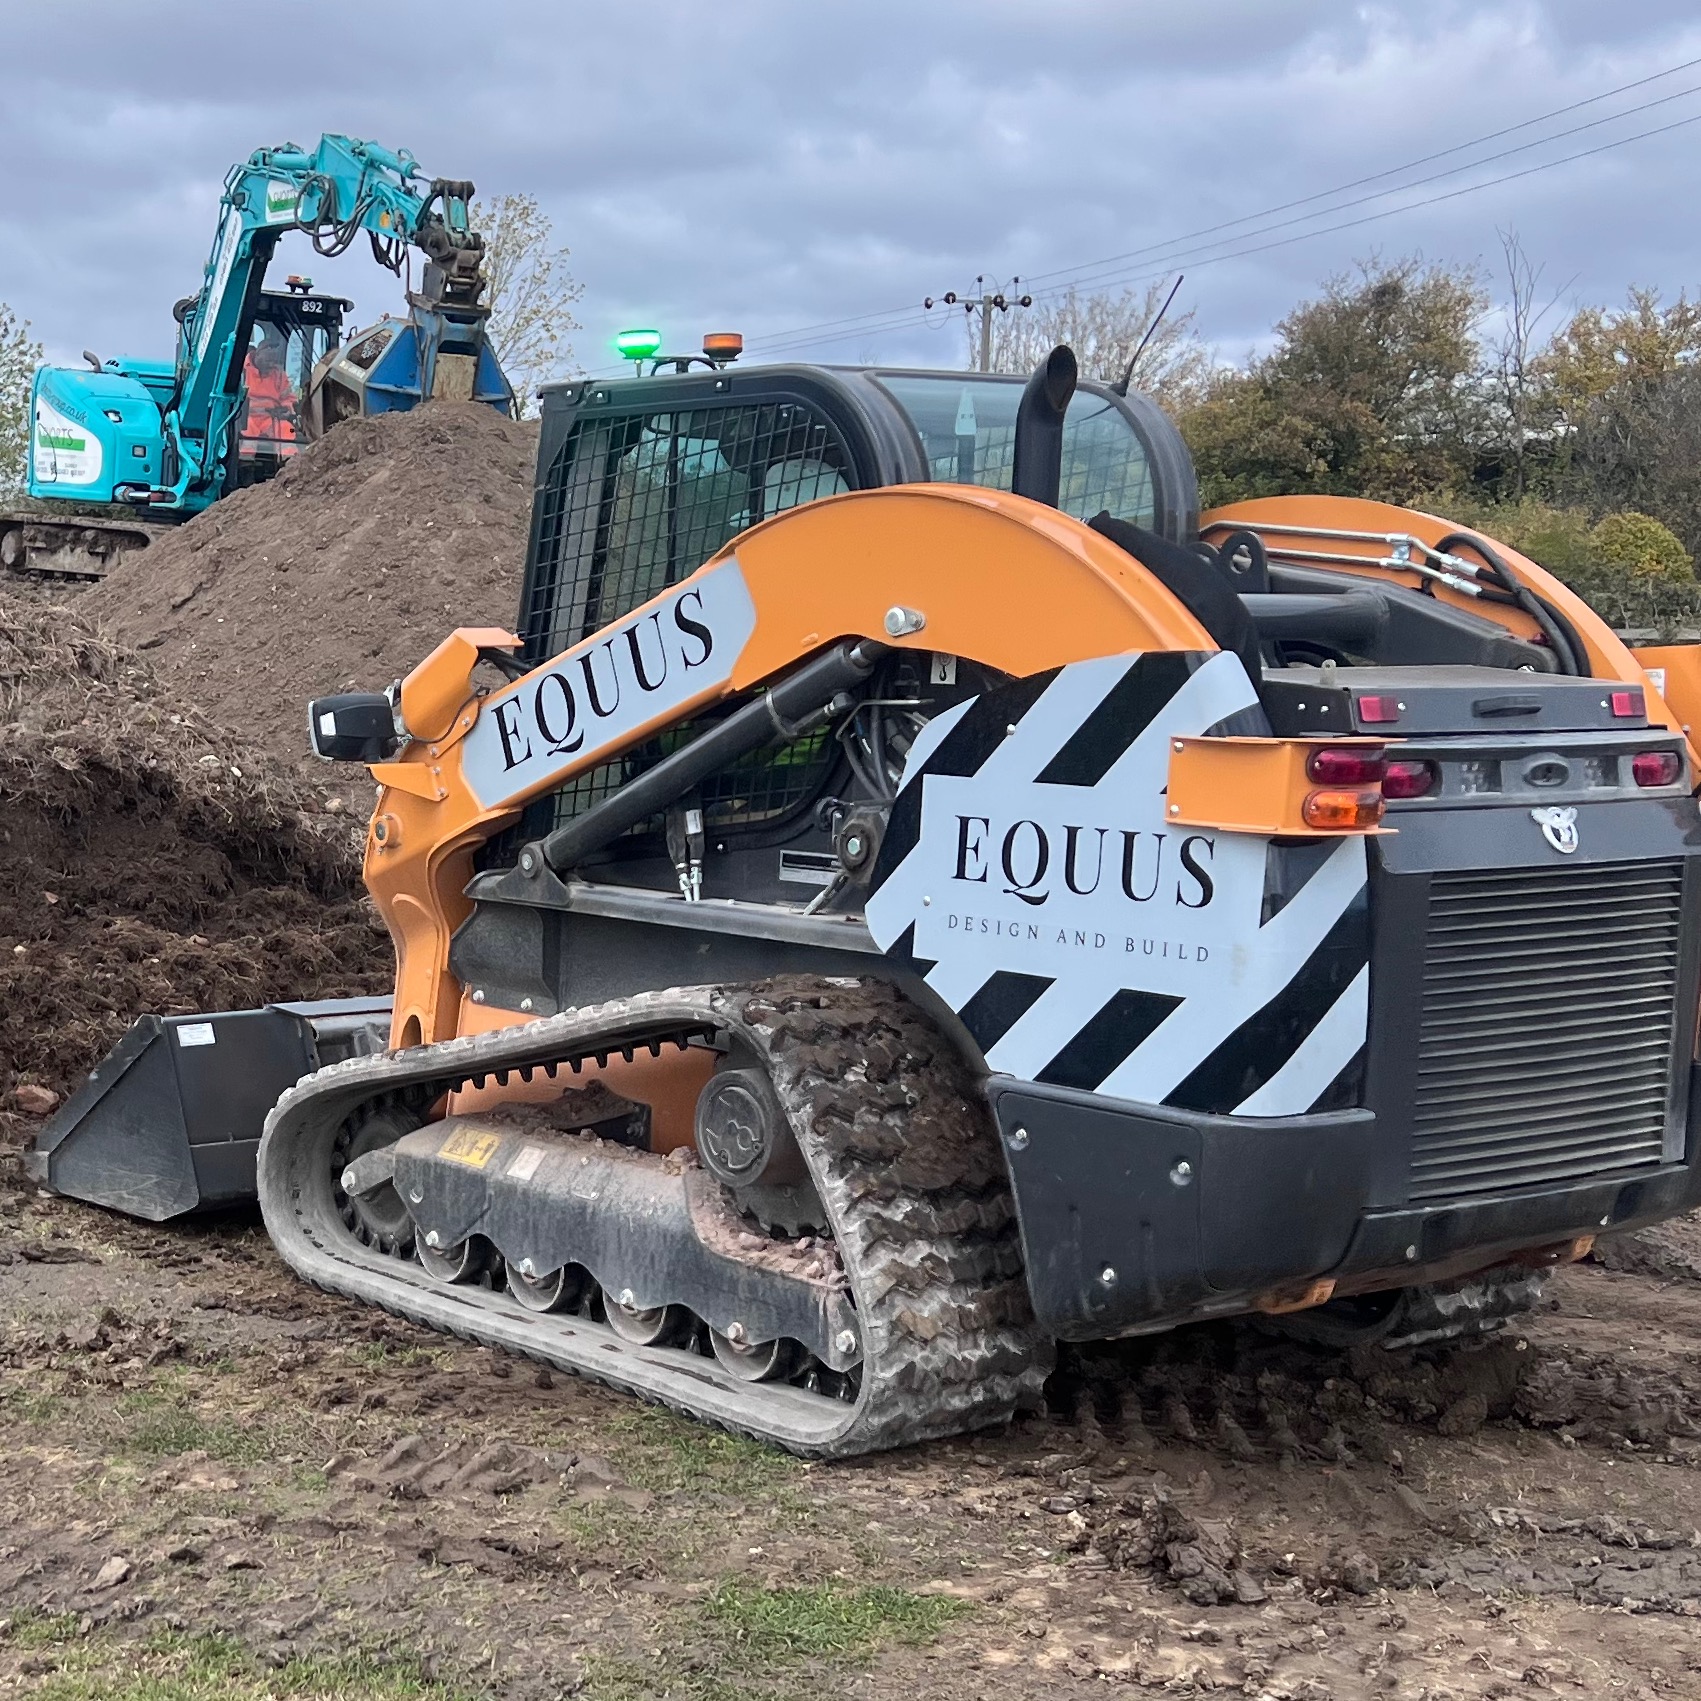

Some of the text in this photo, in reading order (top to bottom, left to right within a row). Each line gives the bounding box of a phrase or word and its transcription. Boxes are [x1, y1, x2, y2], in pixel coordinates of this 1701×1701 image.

[302, 301, 323, 313] 892
[490, 587, 714, 773] EQUUS
[951, 814, 1216, 909] EQUUS
[948, 914, 1209, 962] DESIGN AND BUILD
